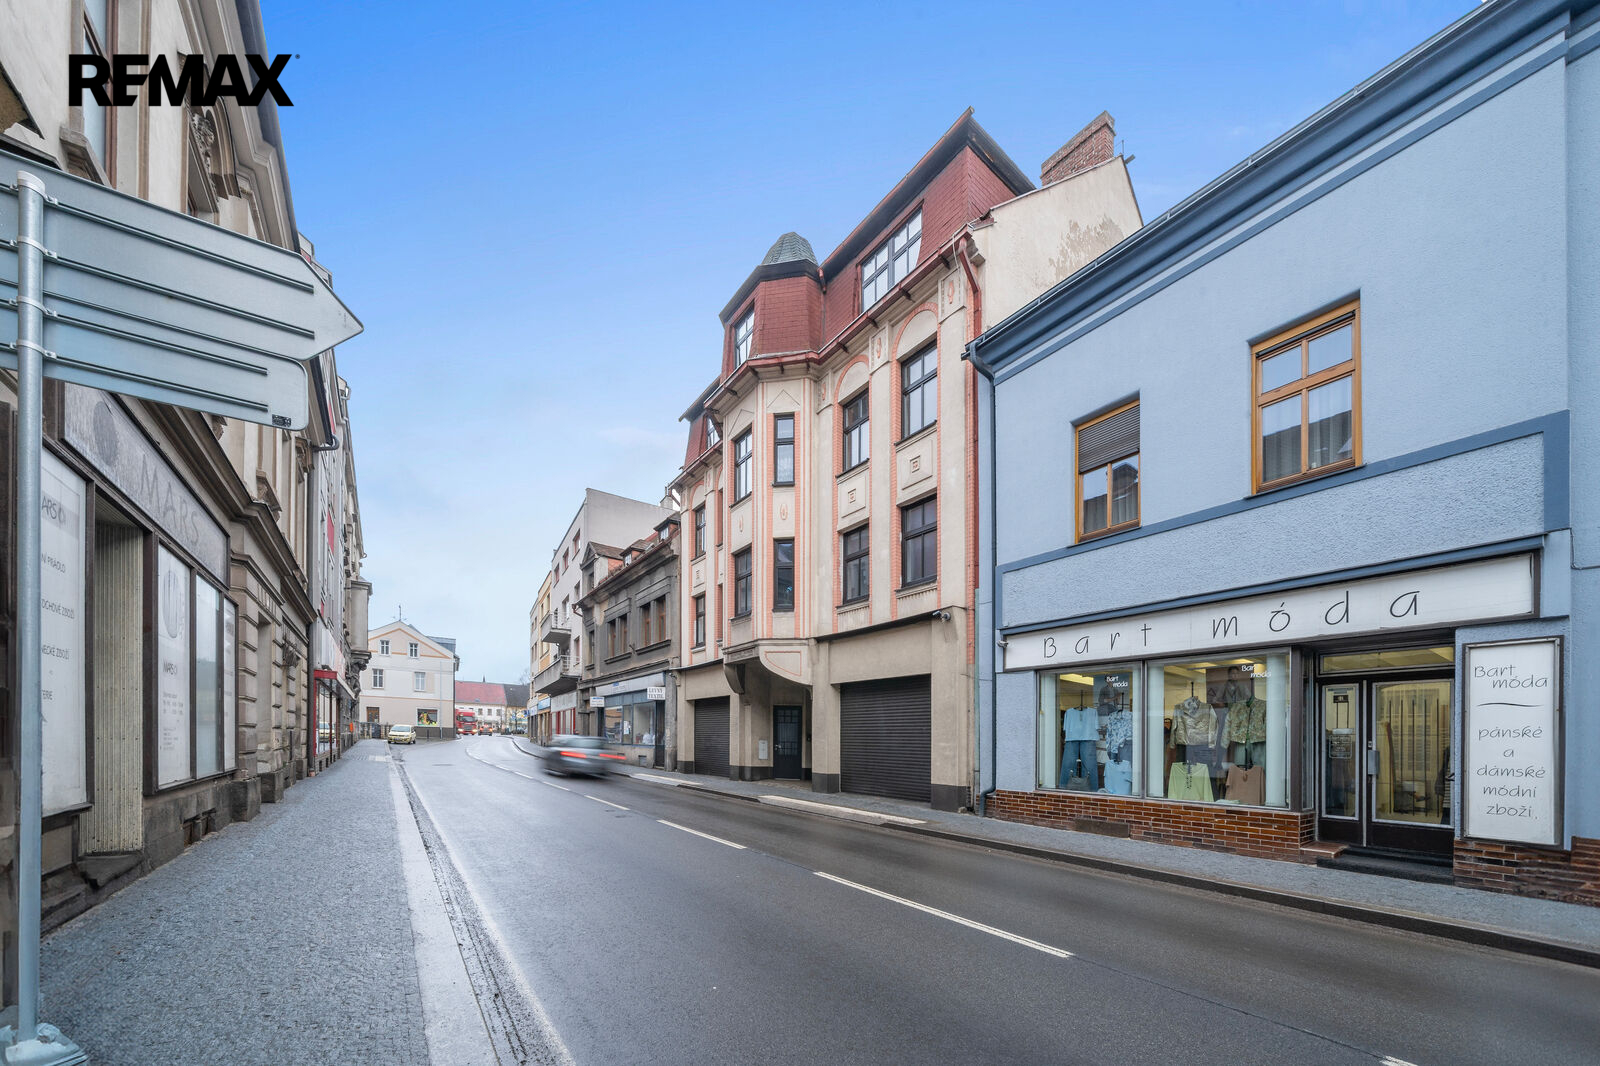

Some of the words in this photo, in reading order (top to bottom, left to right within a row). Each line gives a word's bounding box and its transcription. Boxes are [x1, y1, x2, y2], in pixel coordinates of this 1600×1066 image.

[140, 453, 199, 545] MARS
[42, 495, 57, 520] ARS
[1043, 623, 1151, 658] Bart
[1213, 590, 1420, 640] móda
[1474, 664, 1516, 678] Bart
[1106, 675, 1119, 683] Bart
[1492, 674, 1548, 689] móda
[1478, 725, 1543, 741] pánské
[1503, 748, 1514, 757] a
[1476, 764, 1546, 778] dámské
[1483, 784, 1537, 798] módní
